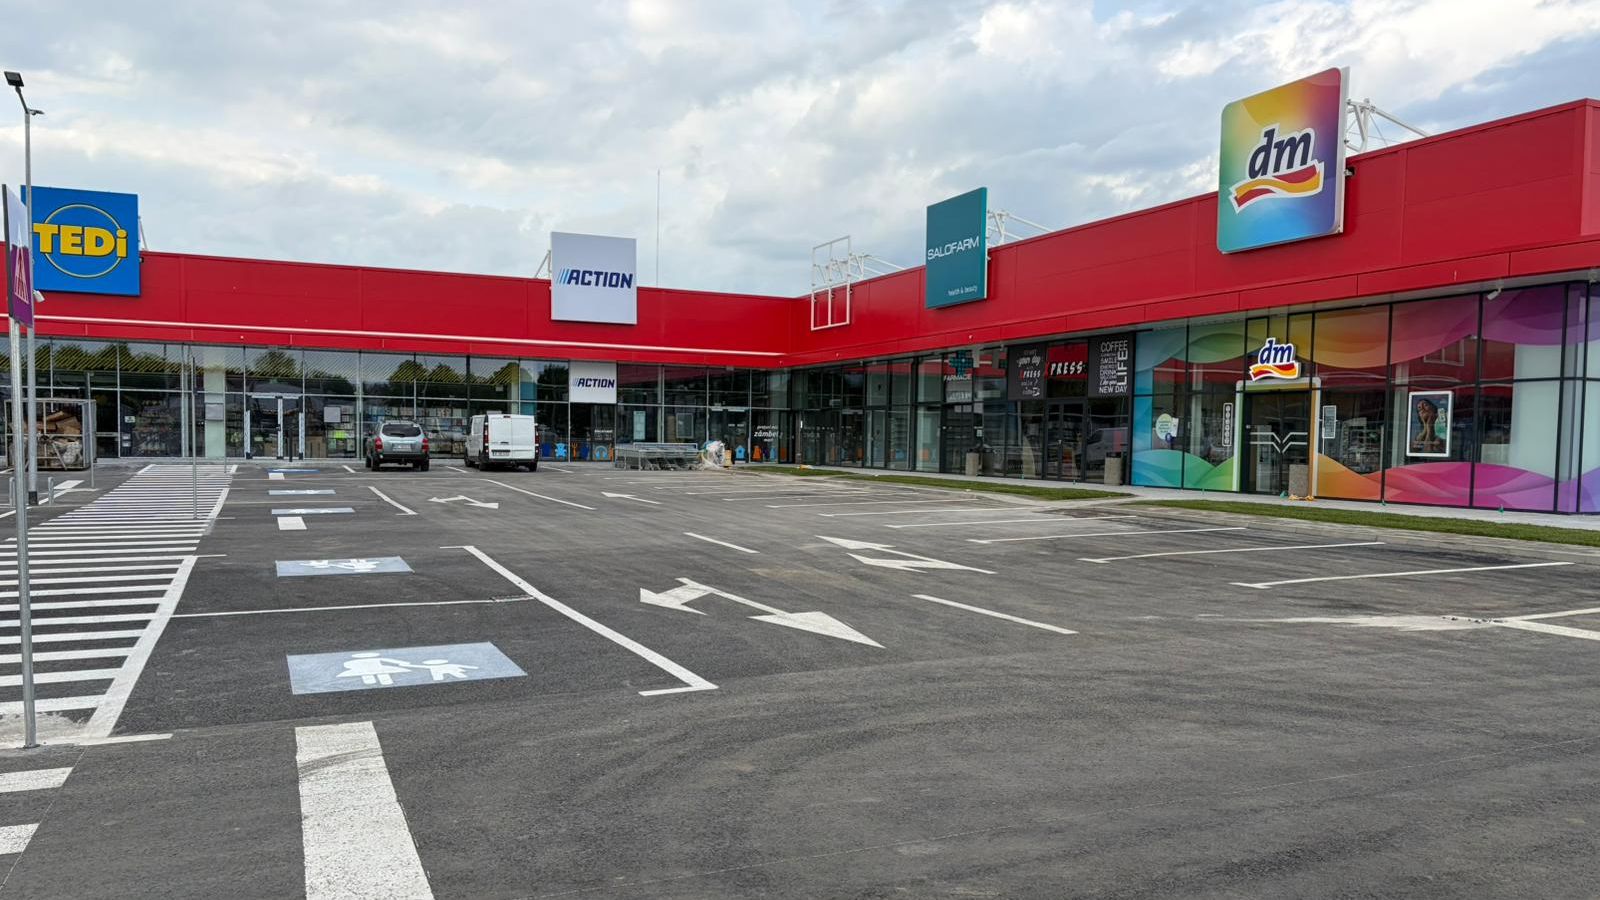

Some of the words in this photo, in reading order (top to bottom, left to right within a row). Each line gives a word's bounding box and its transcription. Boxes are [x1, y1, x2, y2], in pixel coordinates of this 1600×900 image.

[1249, 128, 1312, 179] dm
[33, 223, 128, 258] TEDi
[927, 236, 980, 260] SALOFARM
[566, 269, 634, 289] ACTION
[1100, 340, 1128, 352] COFFEE
[1259, 339, 1294, 365] dm
[1117, 350, 1128, 385] LIFE
[577, 377, 615, 389] ACTION
[1099, 385, 1114, 394] NEW
[1115, 385, 1128, 393] DAY
